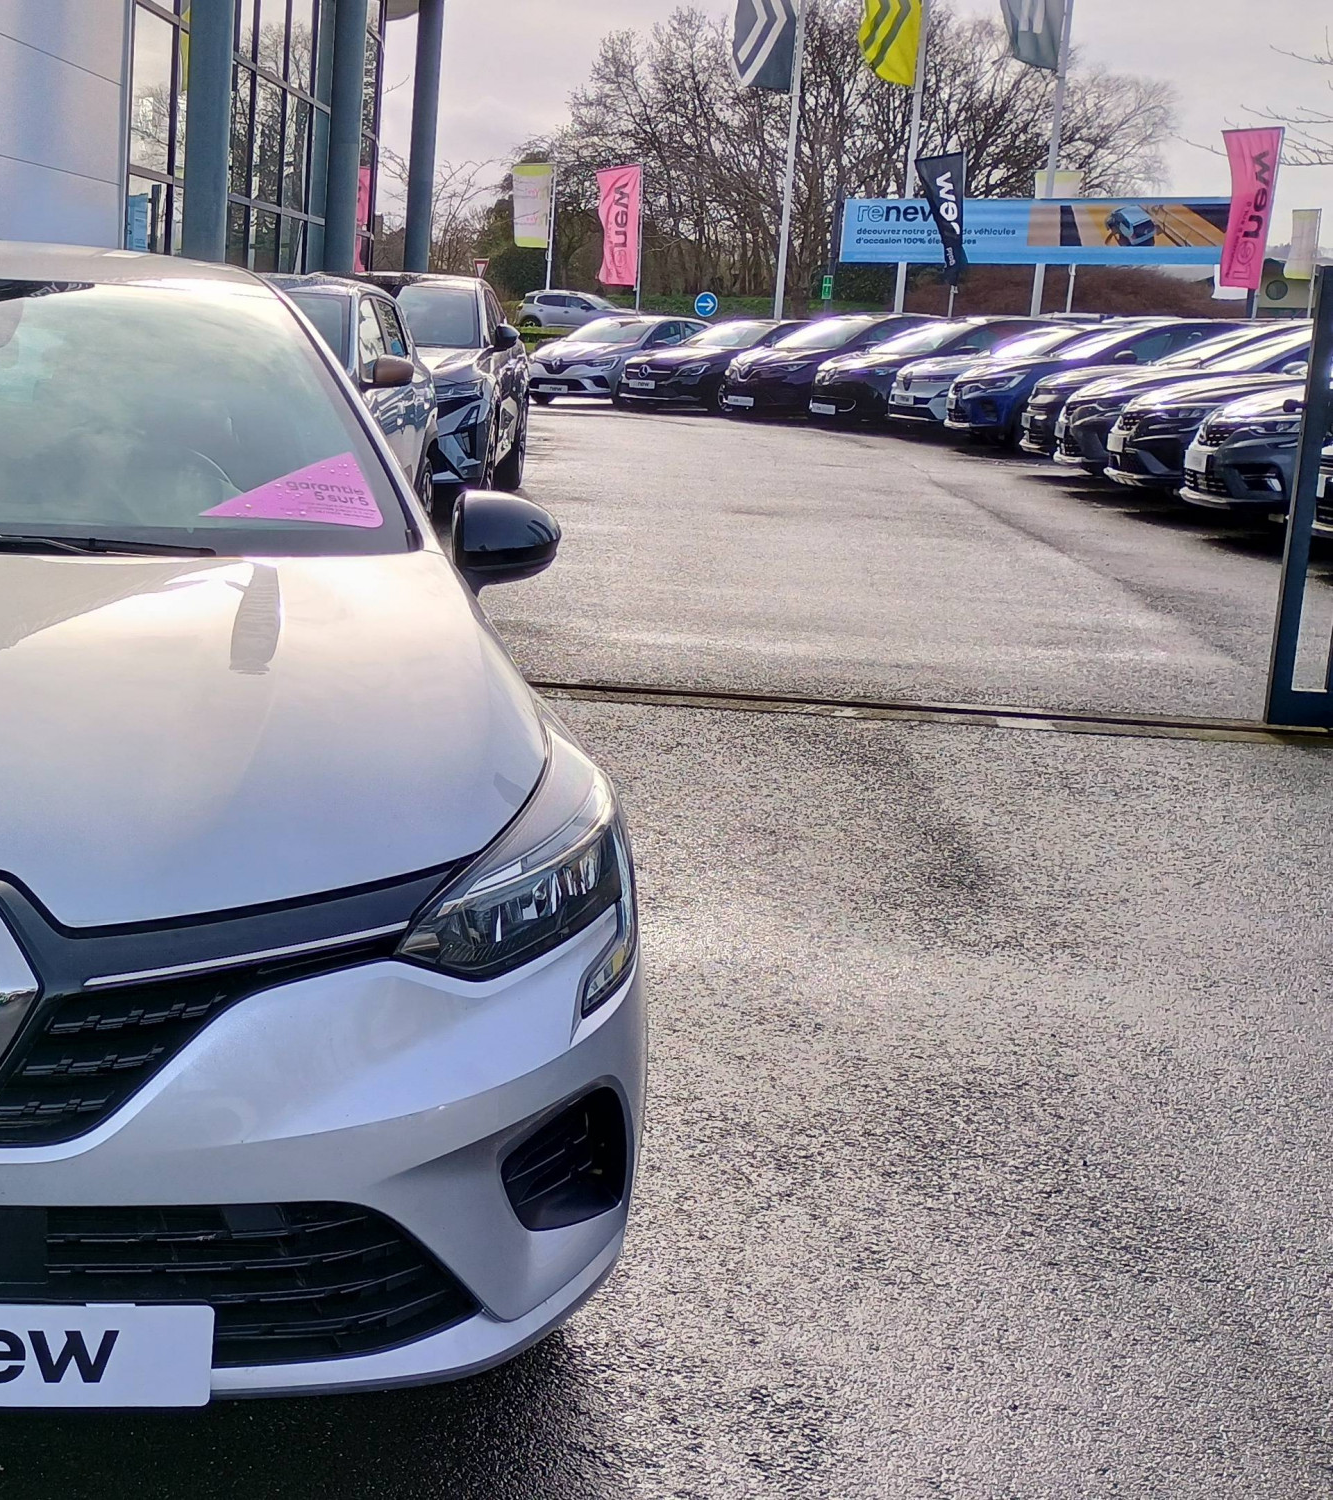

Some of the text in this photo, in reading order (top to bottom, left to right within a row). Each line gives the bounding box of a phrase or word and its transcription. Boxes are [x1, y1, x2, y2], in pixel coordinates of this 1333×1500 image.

[974, 227, 1016, 236] véhicules
[856, 237, 902, 245] d'occasion
[903, 237, 926, 245] 100%
[286, 481, 365, 496] garantie
[314, 491, 369, 507] 5 sur 5
